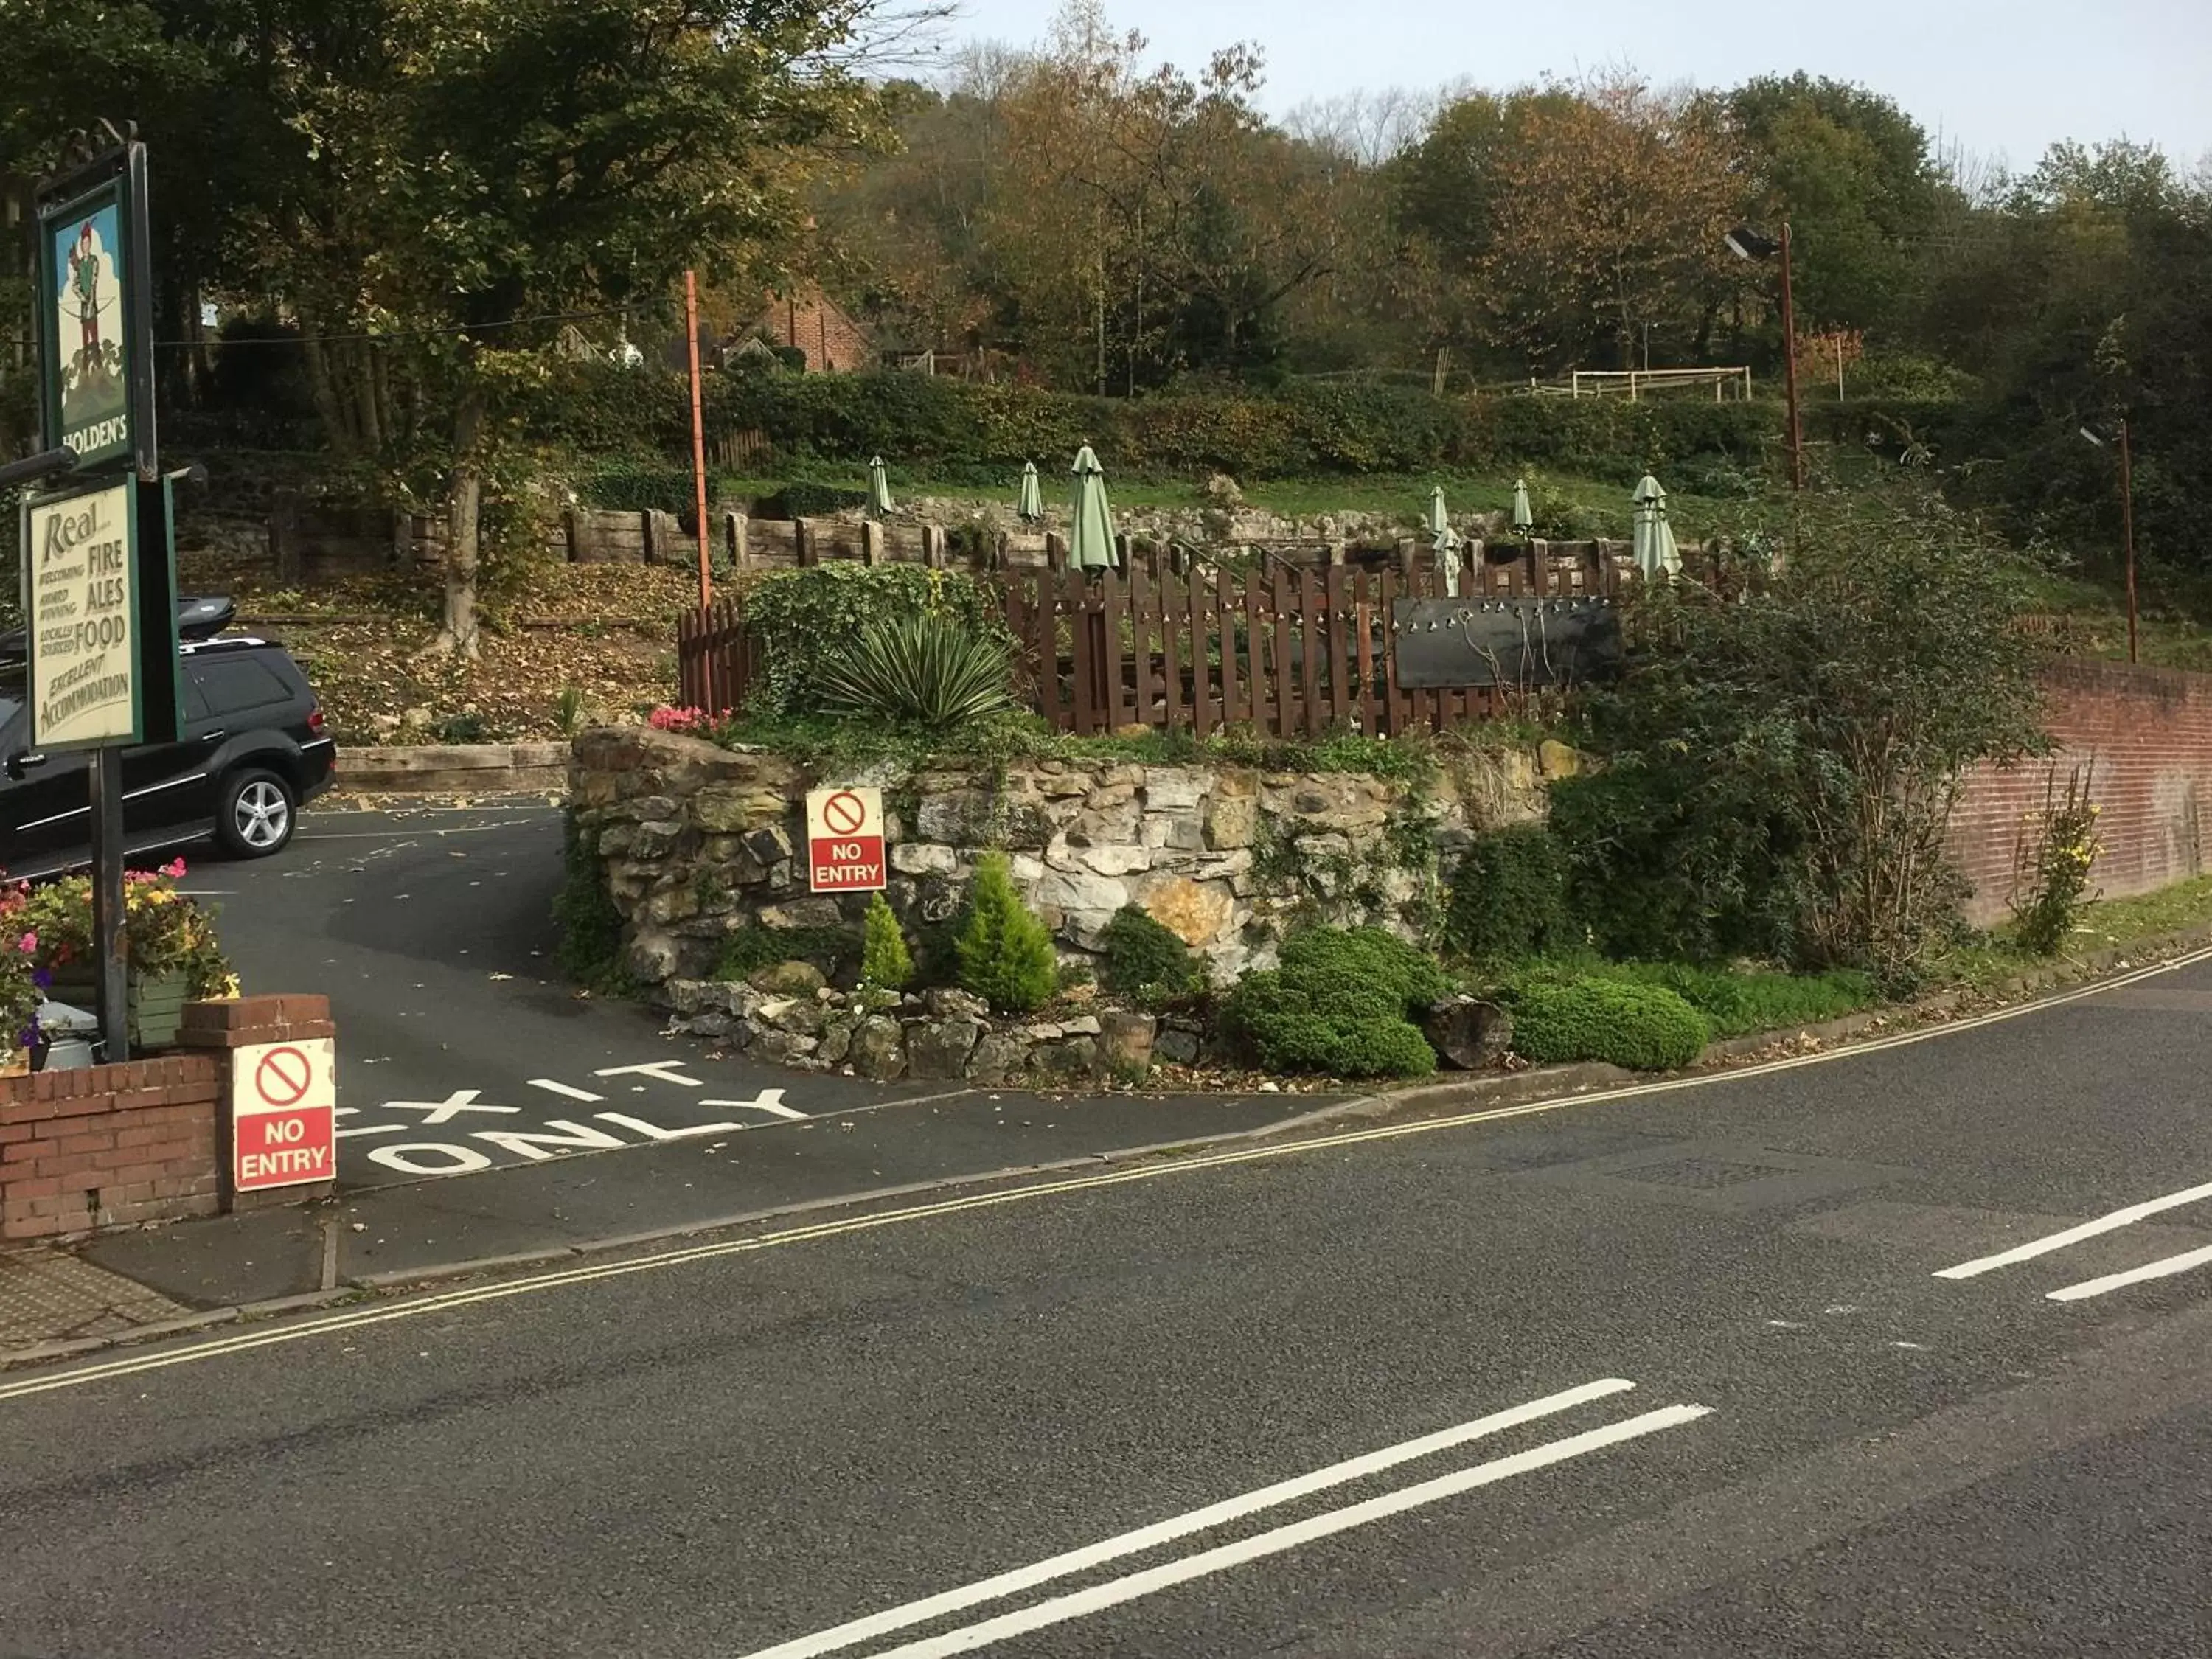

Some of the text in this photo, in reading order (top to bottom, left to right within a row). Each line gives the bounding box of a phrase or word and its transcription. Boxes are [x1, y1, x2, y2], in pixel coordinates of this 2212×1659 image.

[63, 414, 128, 455] HOLDEN'S
[88, 540, 123, 577] FIRE
[86, 577, 125, 613] ALES
[74, 615, 125, 653] FOOD
[49, 653, 105, 698] EXCELLENT
[832, 843, 862, 860] NO
[816, 864, 880, 883] ENTRY
[265, 1119, 305, 1144] NO
[367, 1088, 810, 1175] ONLY
[242, 1146, 327, 1180] ENTRY
